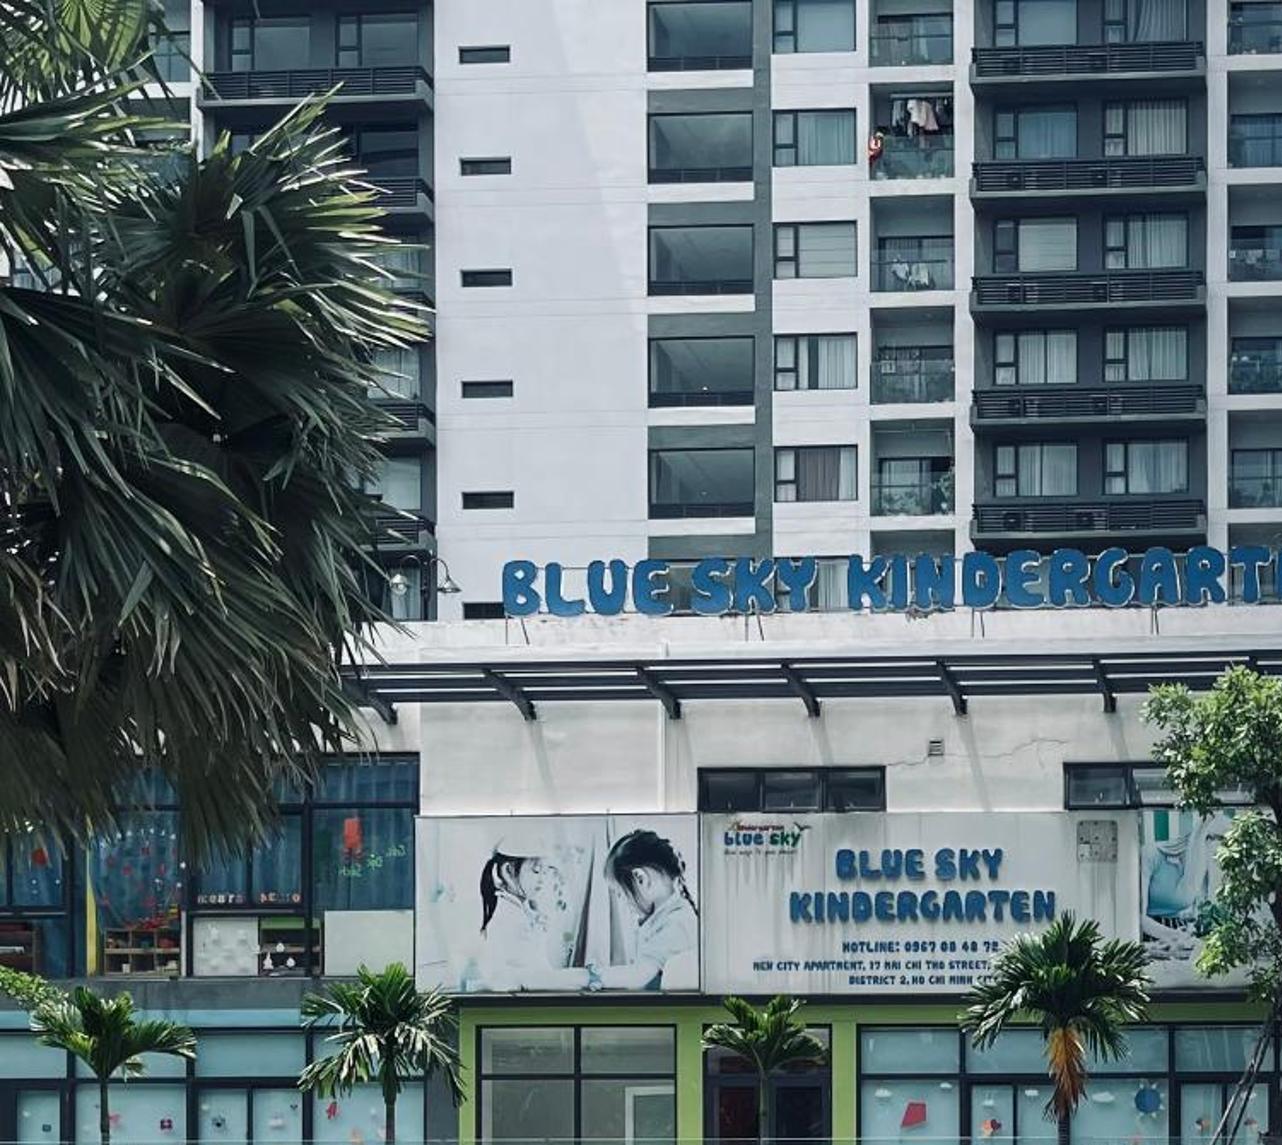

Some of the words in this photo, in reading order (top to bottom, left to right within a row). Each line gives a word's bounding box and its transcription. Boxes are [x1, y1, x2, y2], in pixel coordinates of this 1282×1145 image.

[501, 557, 672, 617] BLUE
[690, 555, 818, 614] SKY
[836, 848, 926, 881] BLUE
[934, 847, 1004, 881] SKY
[789, 890, 1056, 924] KINDERGARTEN
[841, 940, 900, 953] HOTLINE:
[777, 960, 800, 971] CITY
[906, 960, 922, 970] CHI
[848, 975, 896, 985] DISTRICT
[929, 975, 946, 985] CHI
